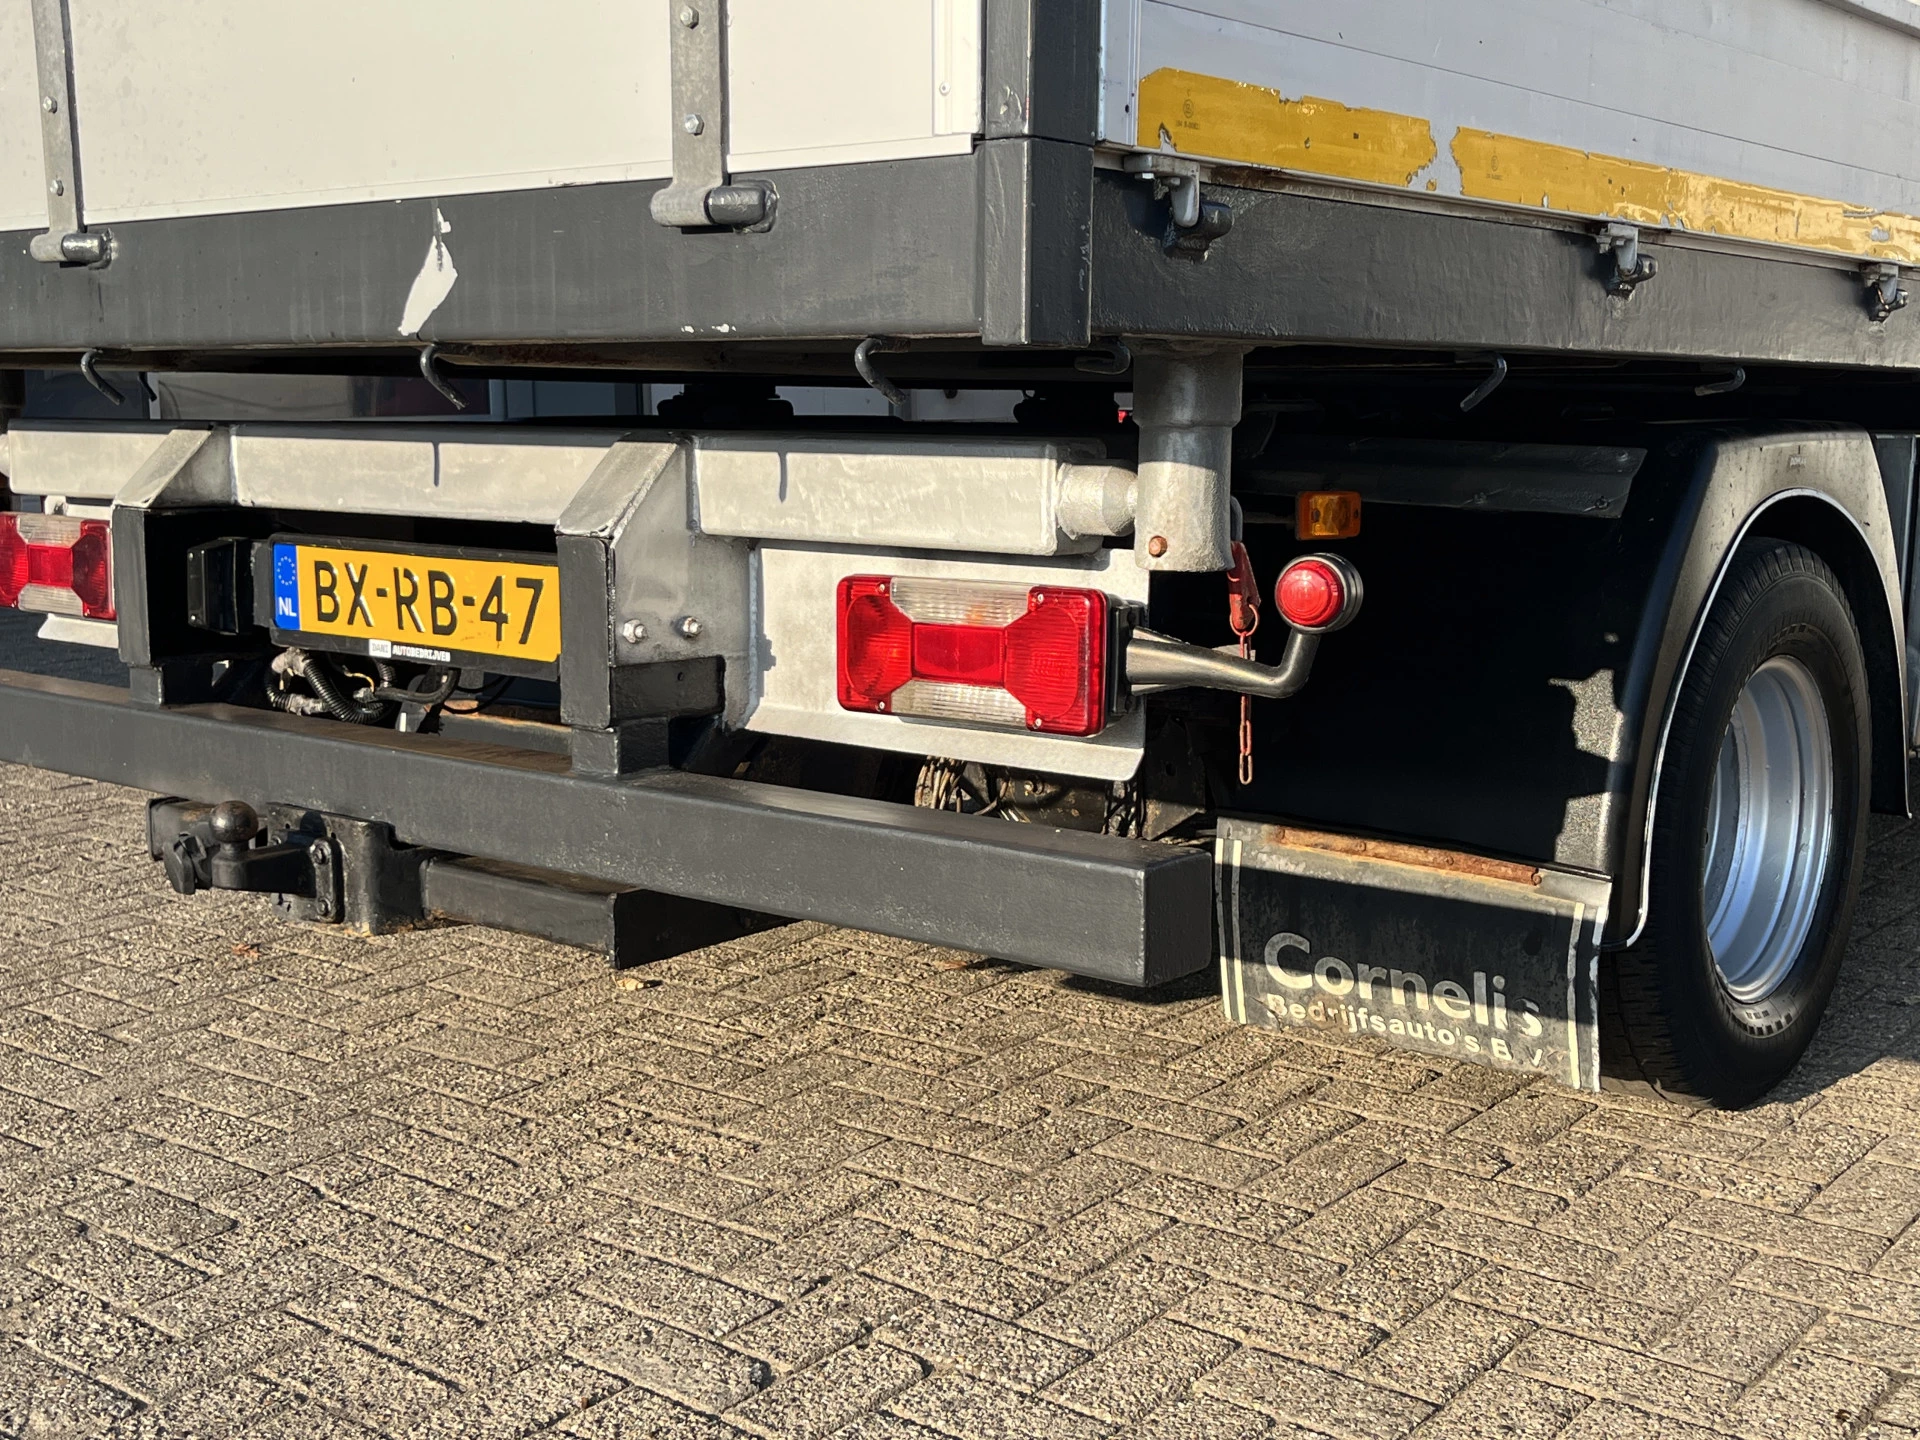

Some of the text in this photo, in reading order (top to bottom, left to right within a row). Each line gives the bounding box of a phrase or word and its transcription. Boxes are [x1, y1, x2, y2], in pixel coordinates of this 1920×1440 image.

[278, 596, 297, 617] NL
[314, 560, 545, 645] BX-RB-47
[1264, 932, 1543, 1037] Cornelis
[1267, 993, 1481, 1053] Bedrijfsauto's
